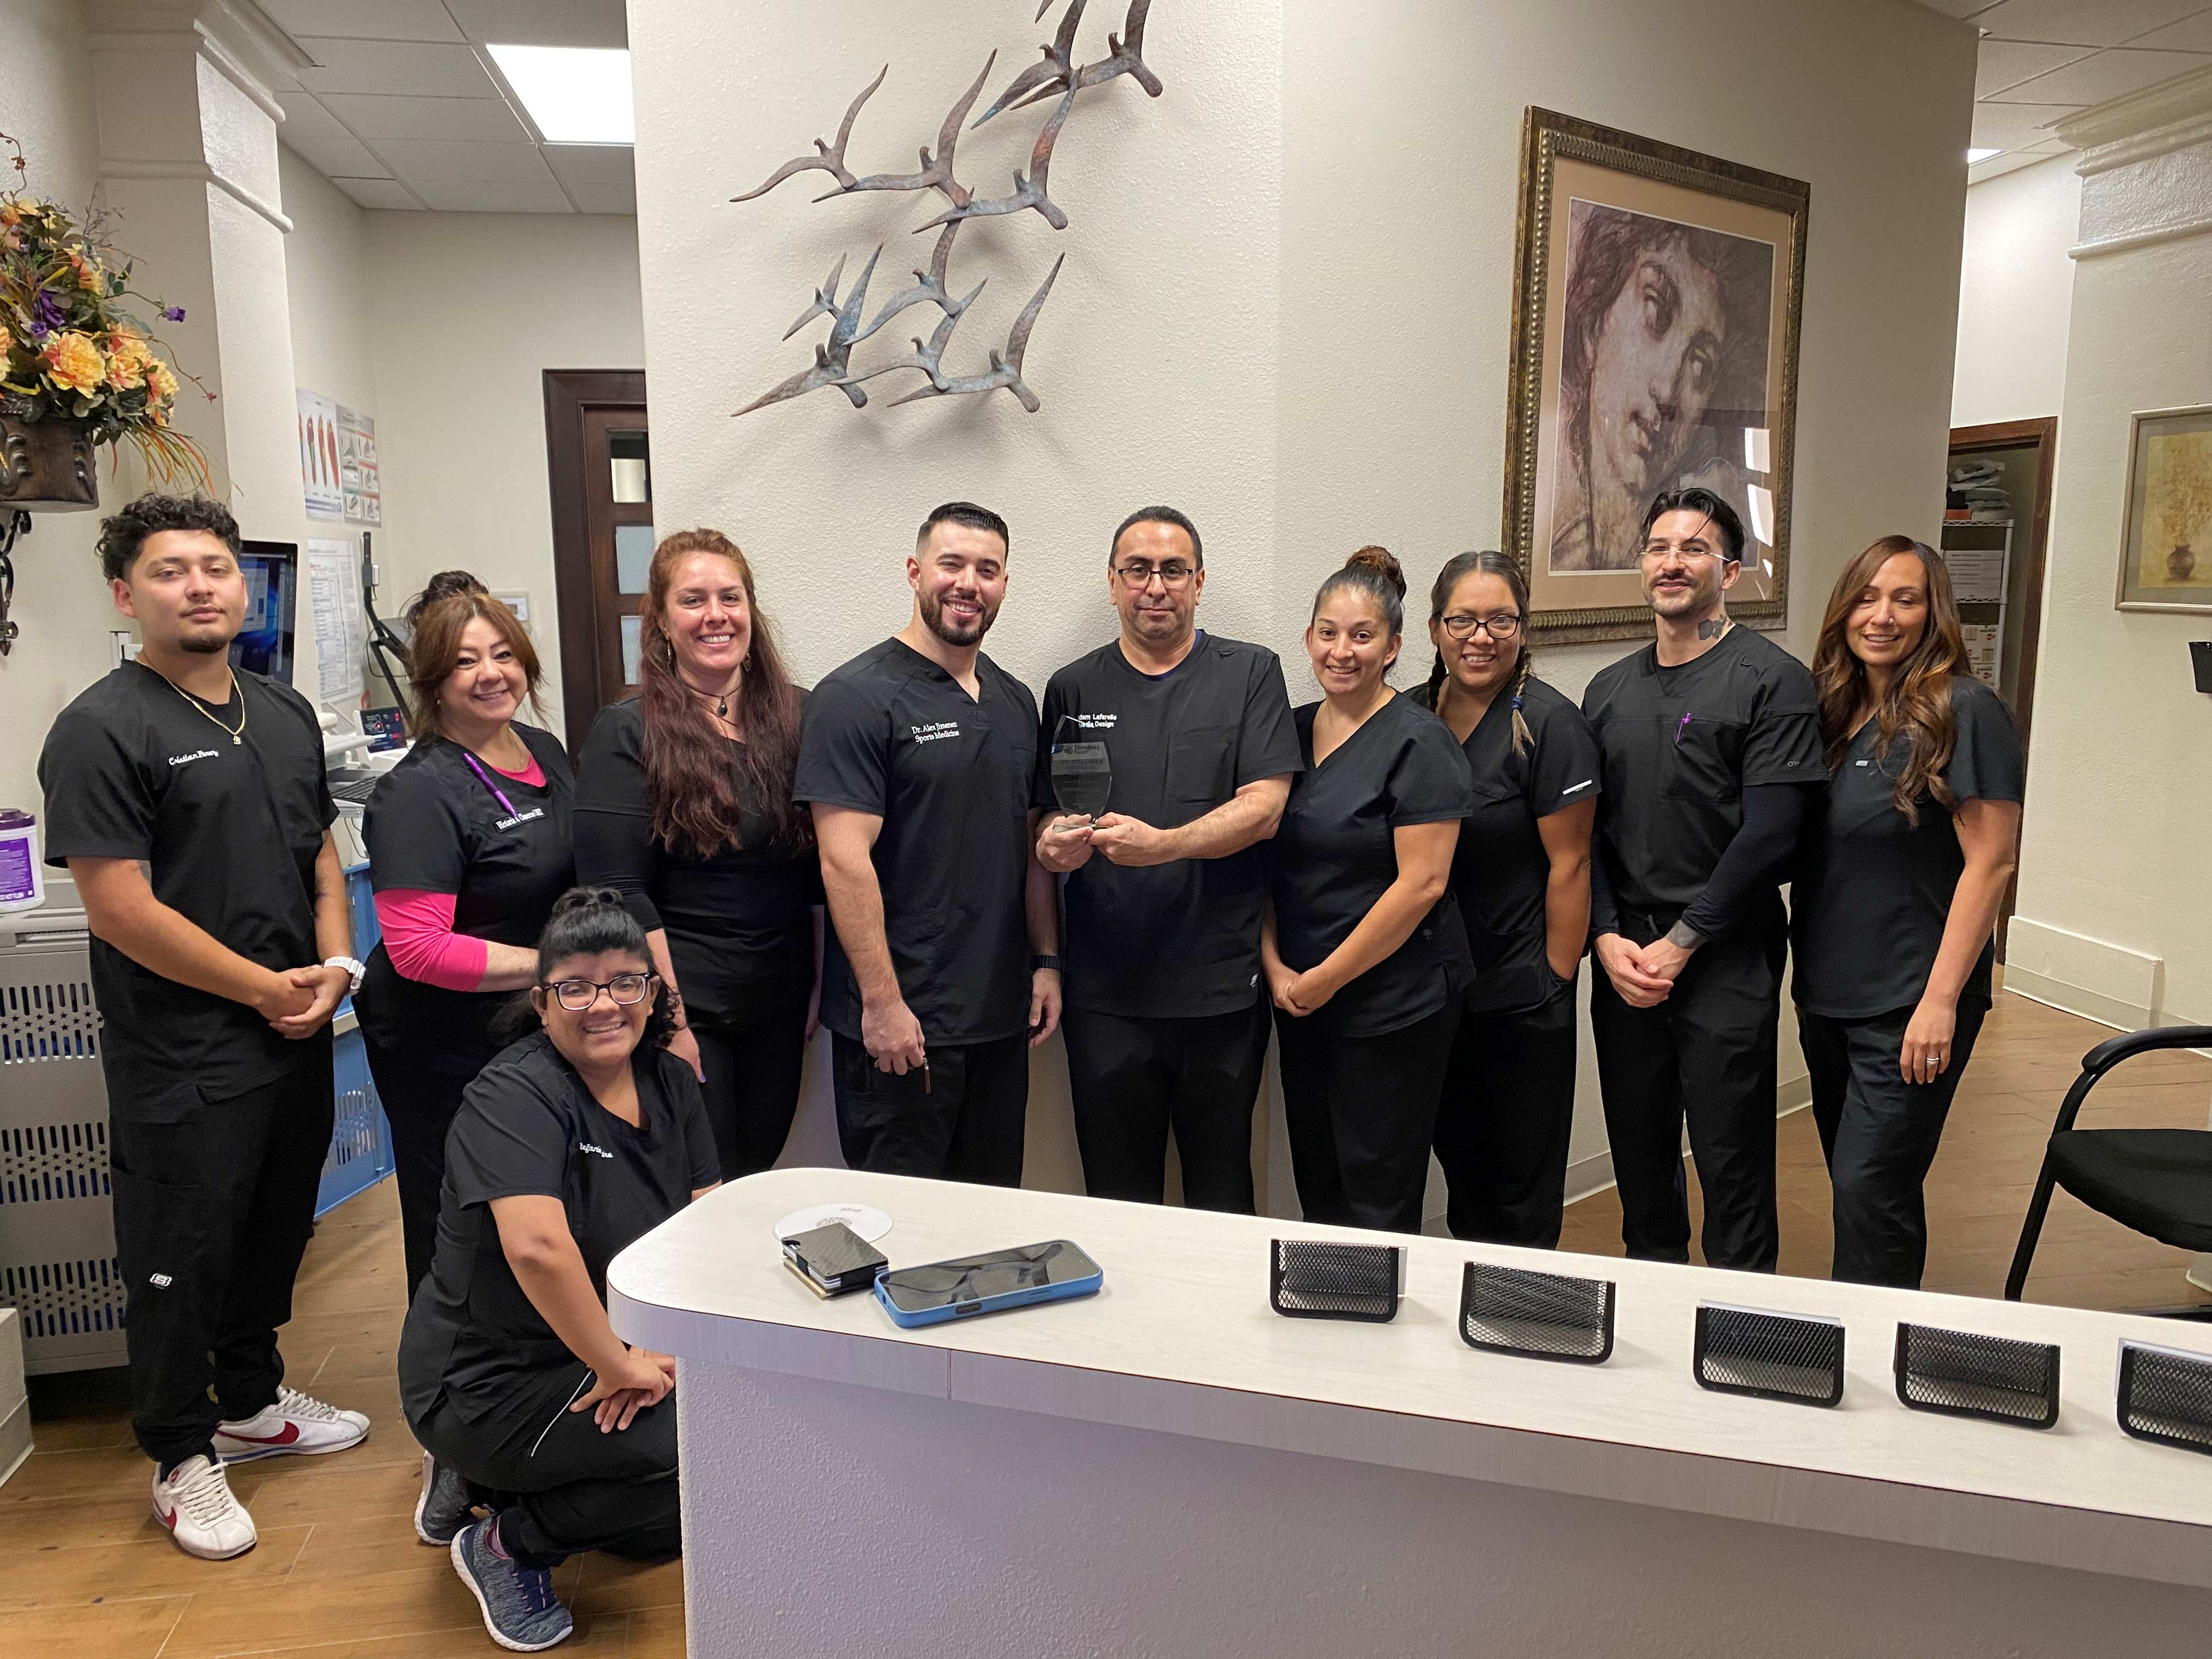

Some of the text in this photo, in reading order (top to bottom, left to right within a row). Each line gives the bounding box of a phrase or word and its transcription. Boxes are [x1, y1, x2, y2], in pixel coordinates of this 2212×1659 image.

[911, 721, 958, 734] Dr. Alex Jimenez
[1094, 720, 1114, 729] Design
[915, 730, 960, 744] Sports Medicine
[168, 753, 198, 766] Cristian
